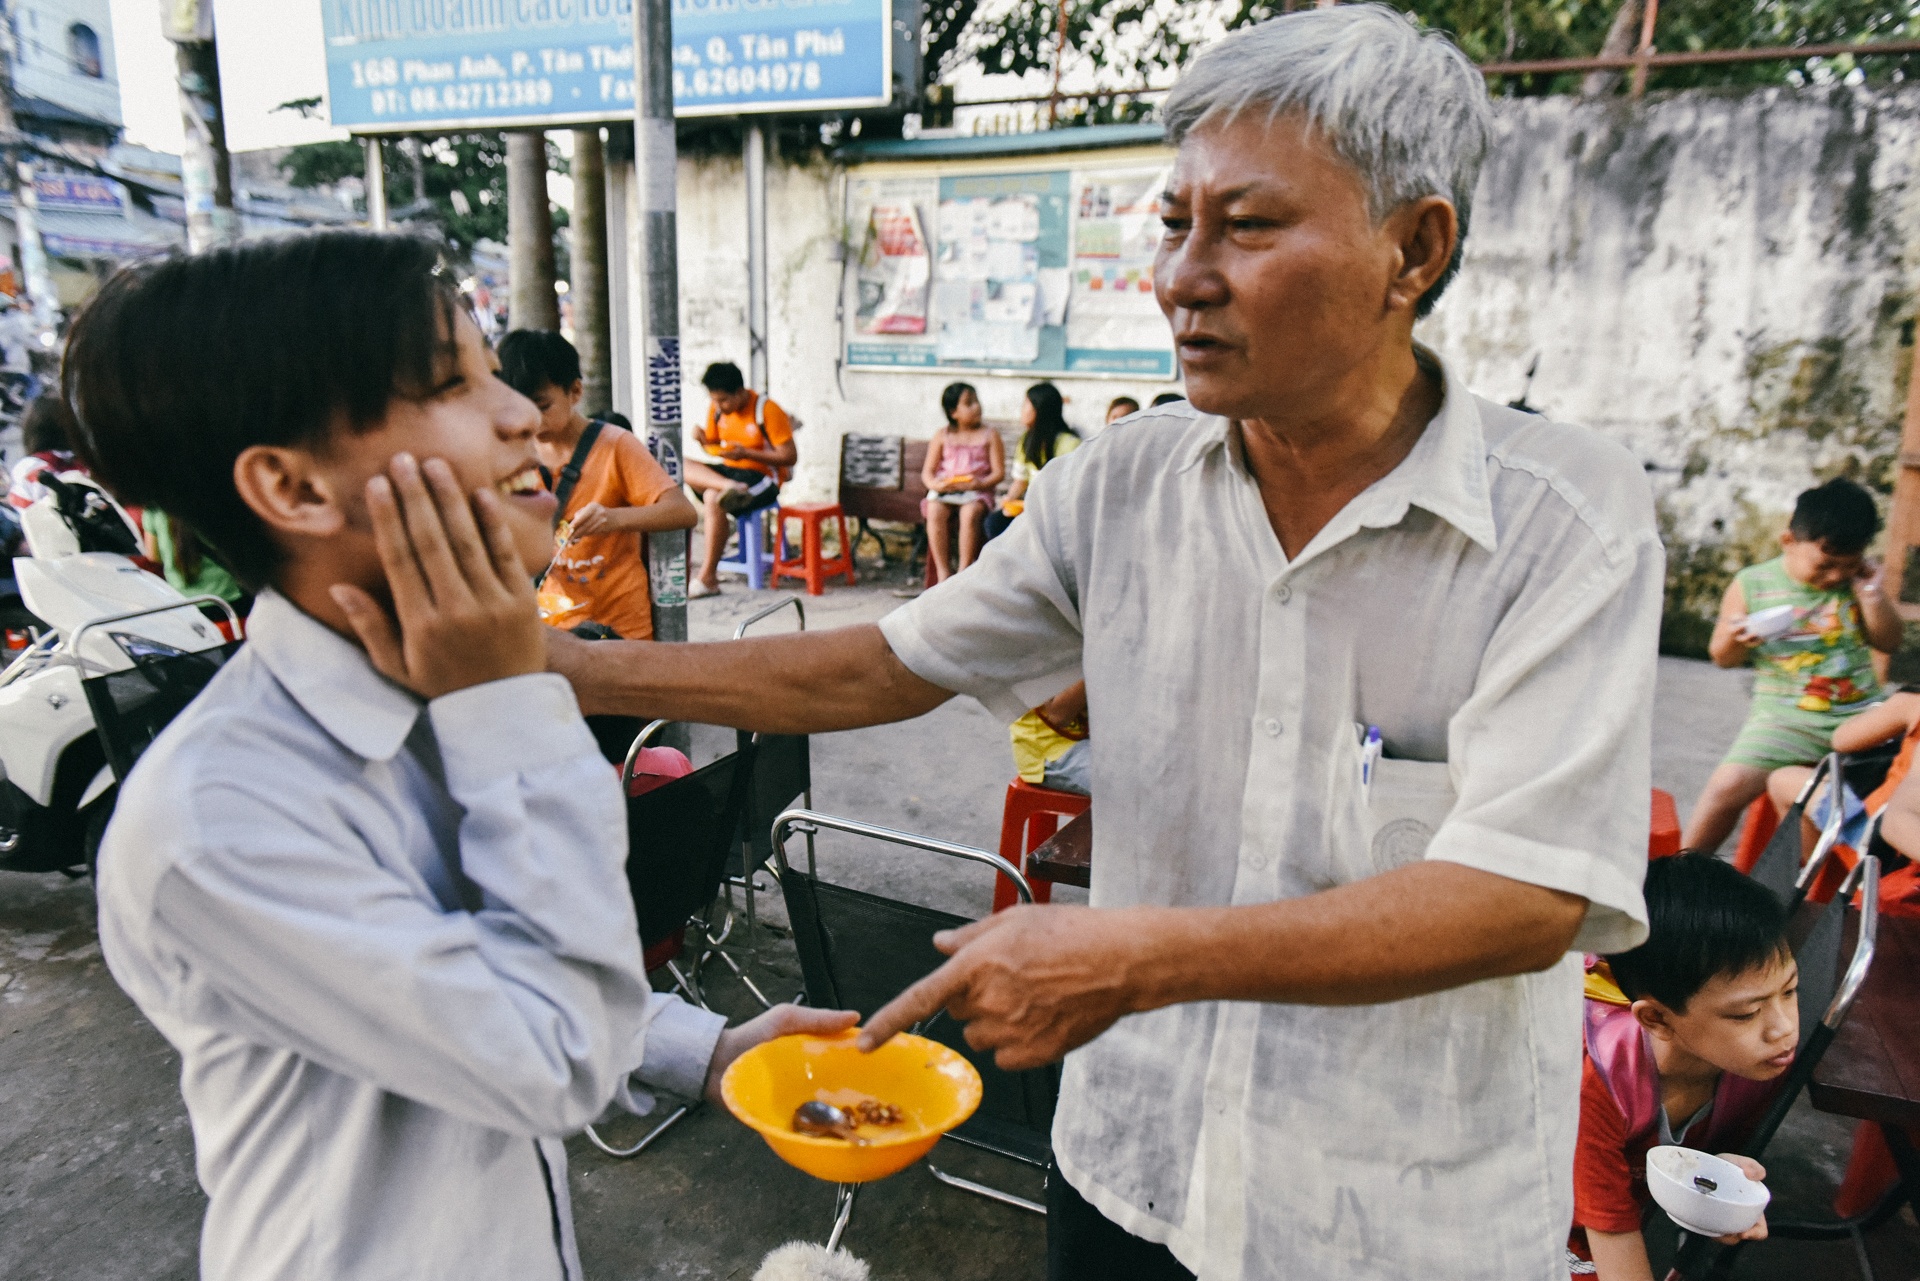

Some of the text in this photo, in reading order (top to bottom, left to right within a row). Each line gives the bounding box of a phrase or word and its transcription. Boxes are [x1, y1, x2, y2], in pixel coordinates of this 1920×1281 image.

[352, 56, 398, 88] 168
[403, 59, 455, 84] Phan
[706, 36, 734, 65] Q.
